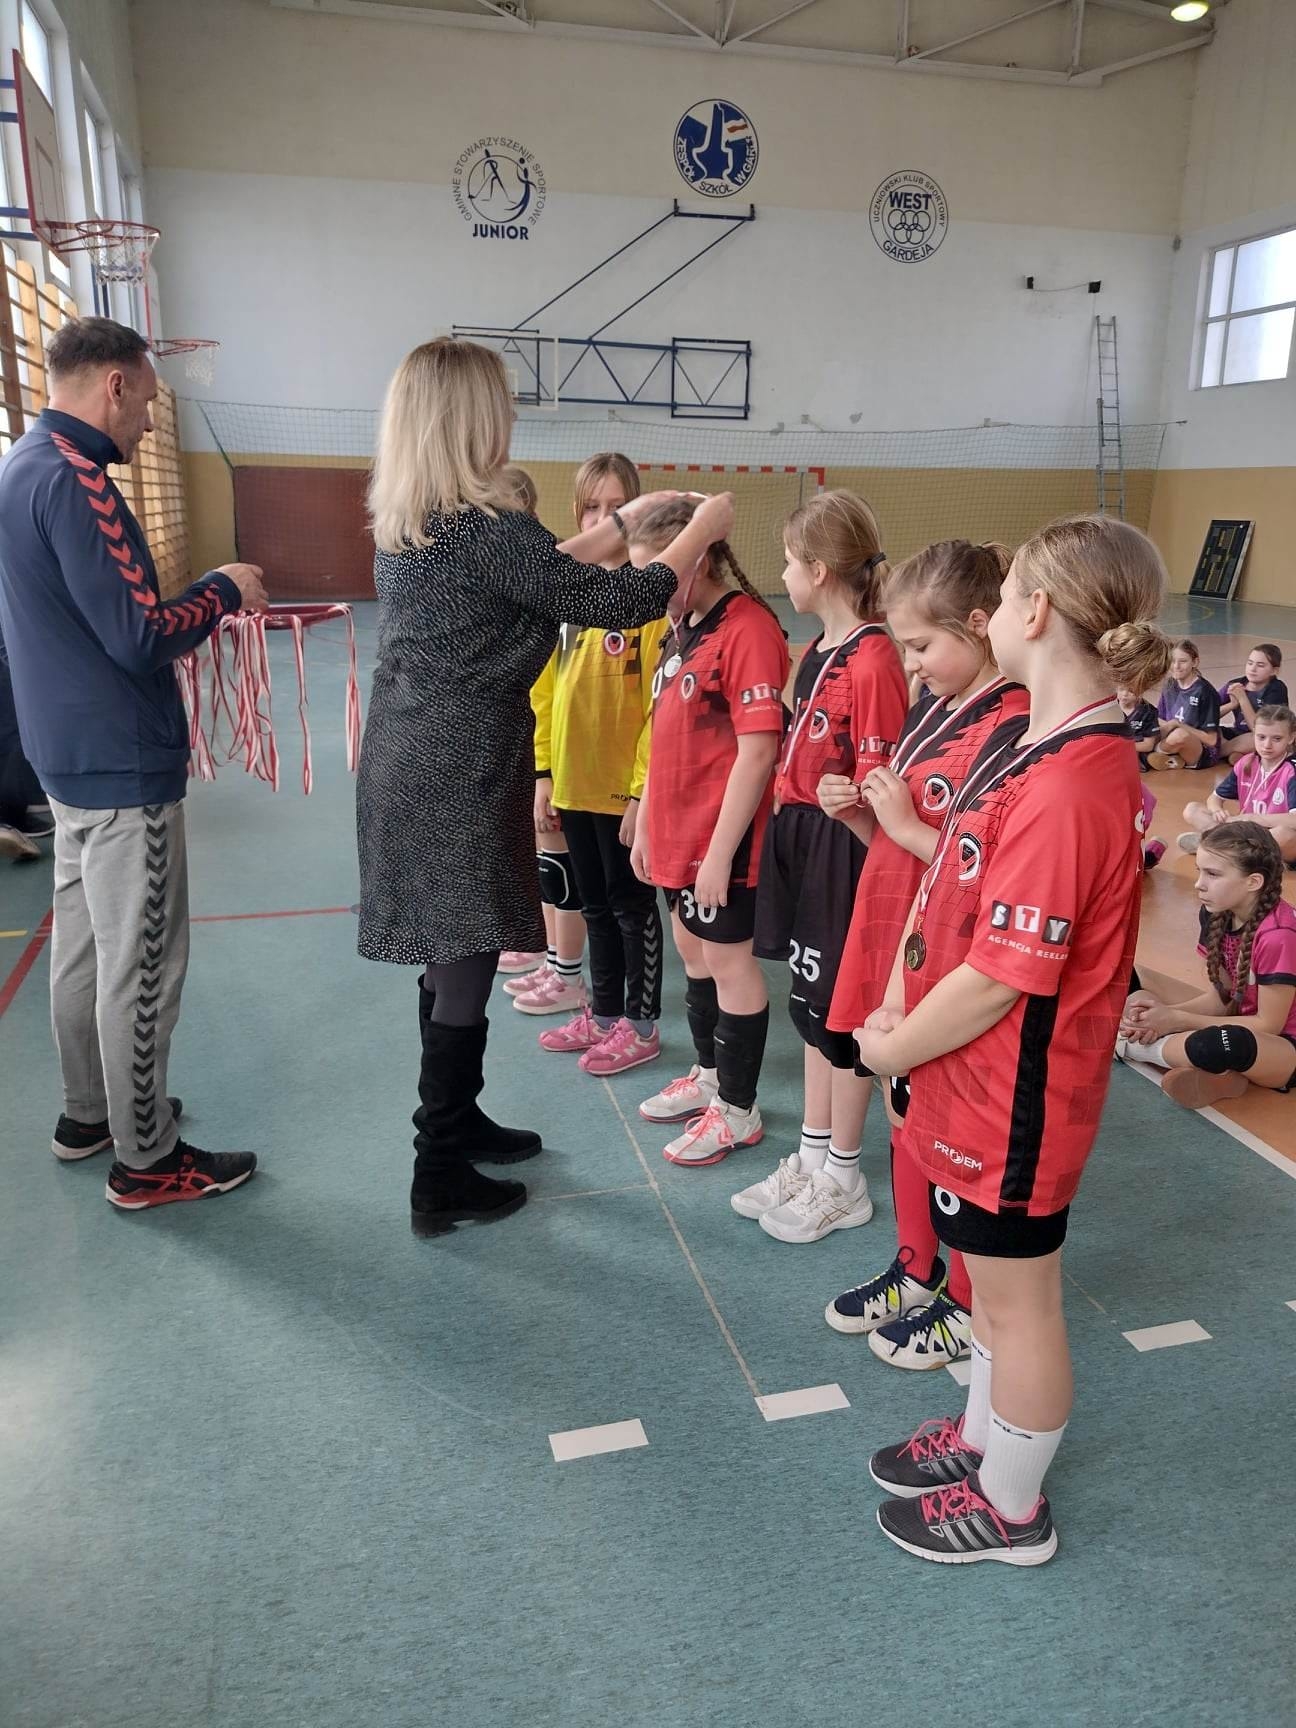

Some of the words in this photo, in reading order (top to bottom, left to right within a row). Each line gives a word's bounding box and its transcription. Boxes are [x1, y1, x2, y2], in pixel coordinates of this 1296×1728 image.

[454, 136, 536, 176] STOWARZYSZENIE
[452, 178, 473, 222] GMINNE
[527, 163, 547, 226] SPORTOWE
[873, 176, 902, 223] UCZNIOWSKI
[902, 174, 925, 185] KLUB
[924, 180, 946, 228] SPORTOWY
[888, 190, 932, 211] WEST
[472, 223, 529, 241] JUNIOR
[882, 240, 935, 262] GARDEJA
[1174, 706, 1185, 722] 4
[680, 889, 718, 924] 30
[788, 938, 822, 983] 25
[987, 934, 1032, 955] AGENCJA
